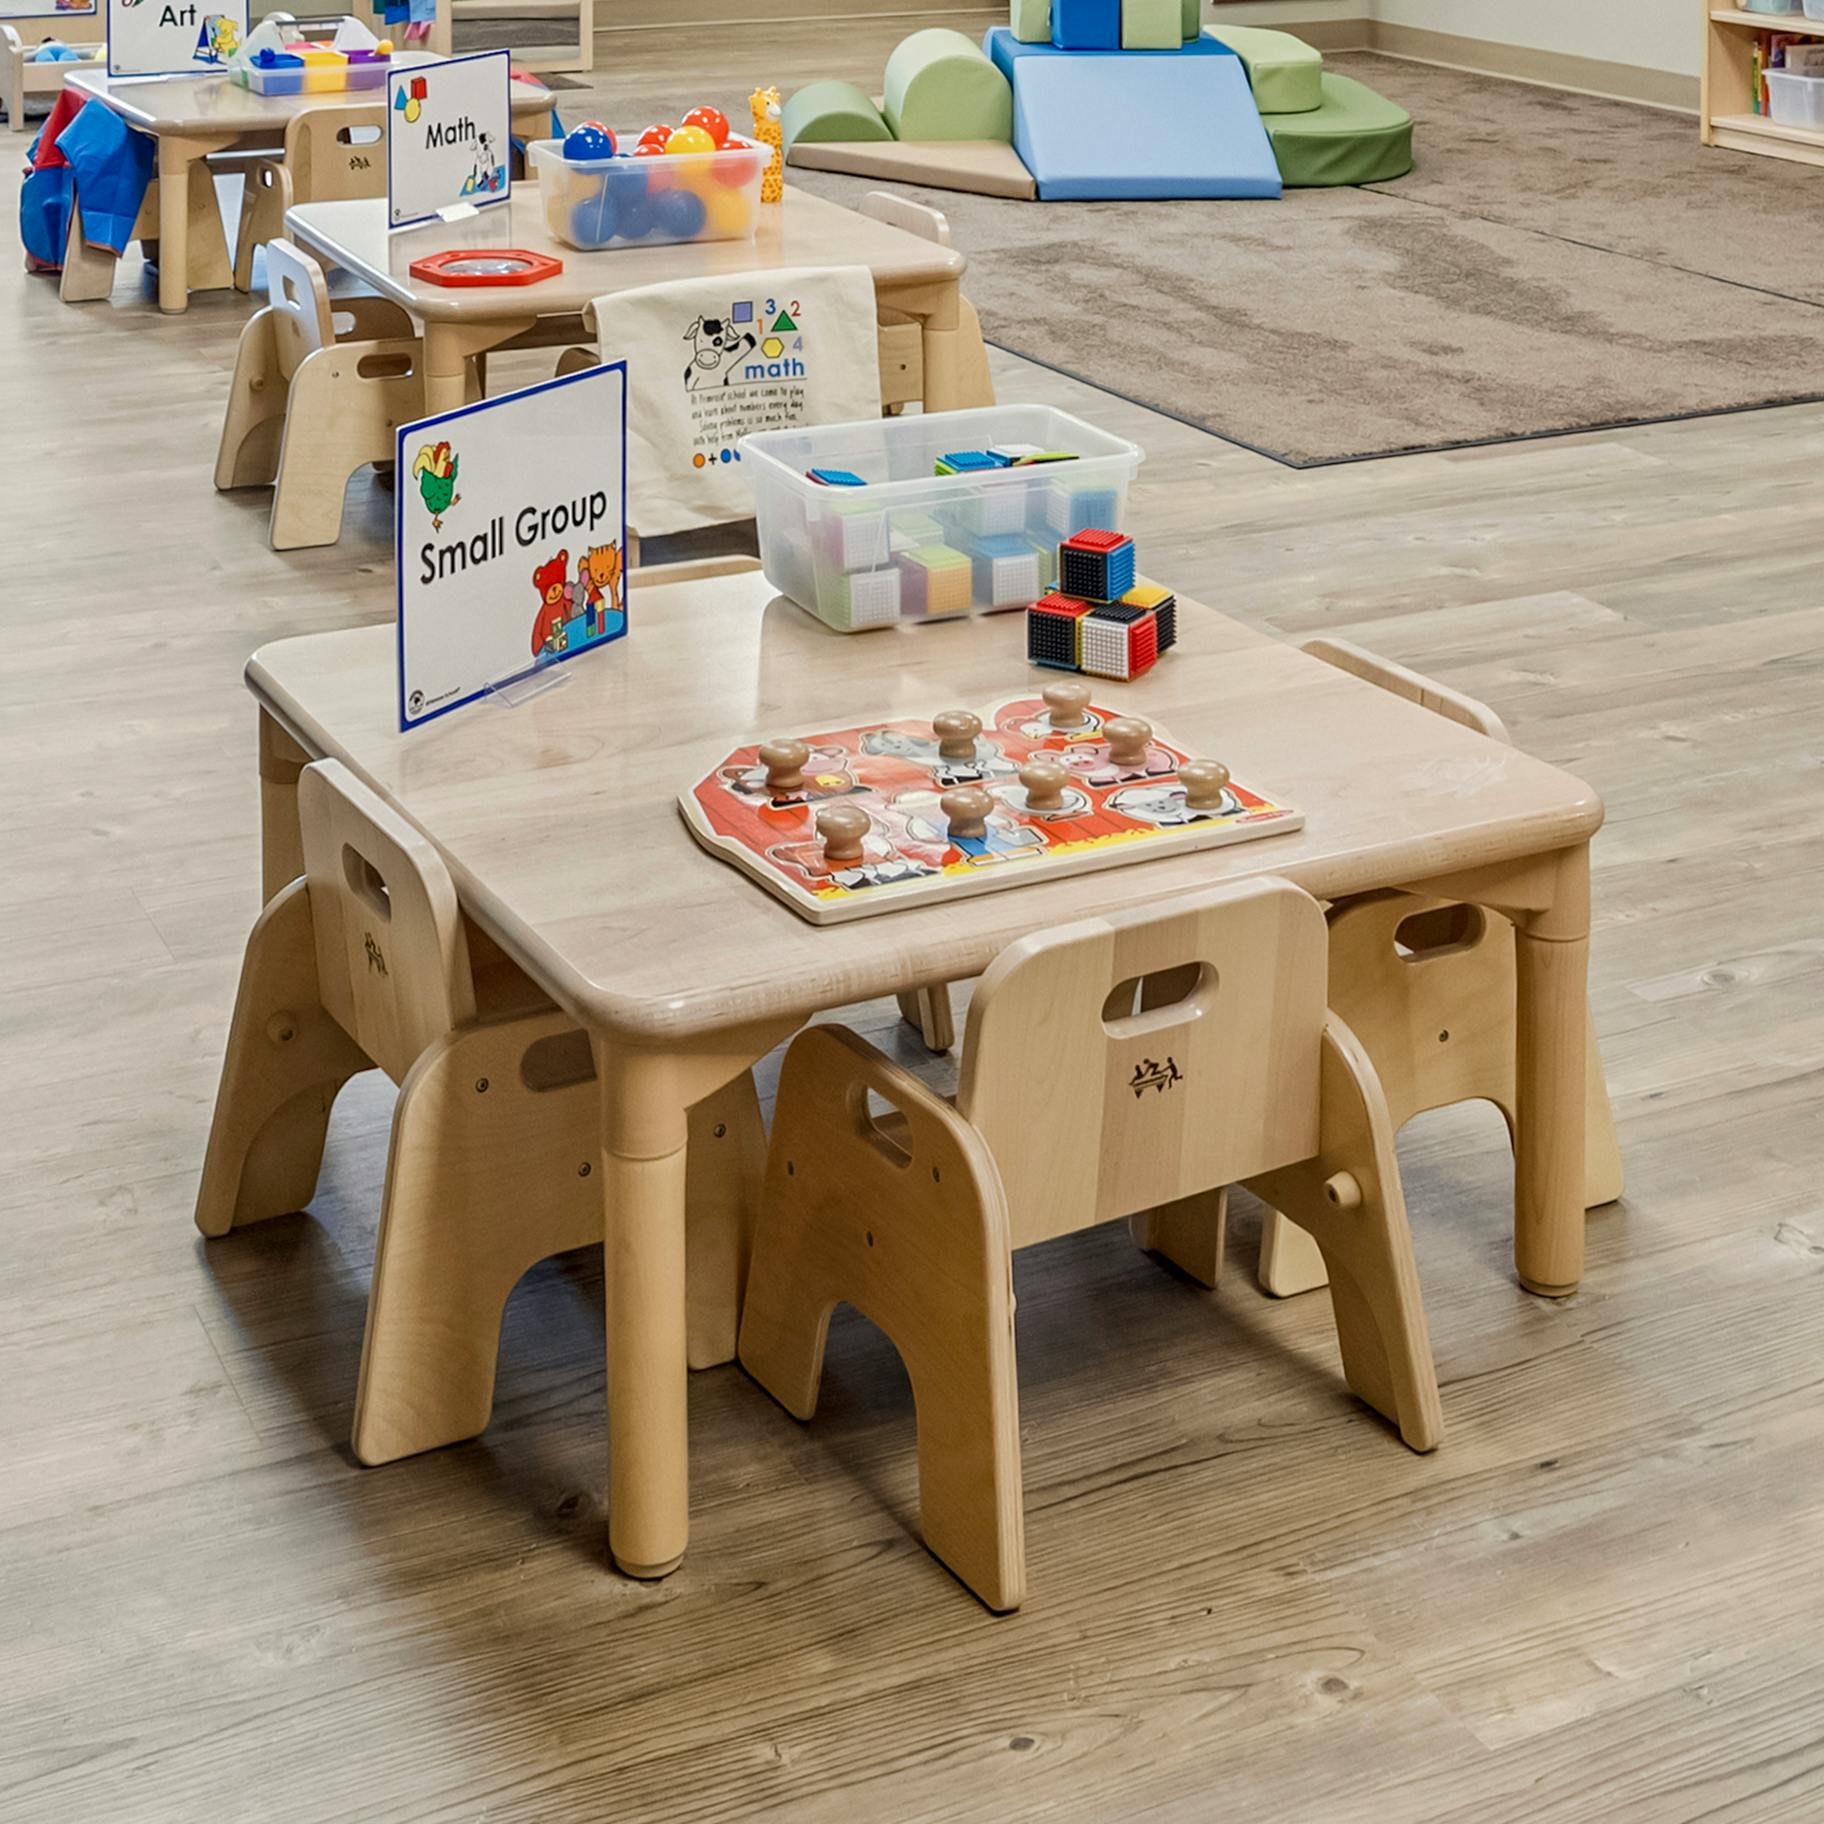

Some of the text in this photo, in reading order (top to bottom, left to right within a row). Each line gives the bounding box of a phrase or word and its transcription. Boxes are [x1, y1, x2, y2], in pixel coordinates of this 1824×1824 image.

[159, 3, 197, 27] Art
[425, 115, 476, 150] Math
[765, 298, 801, 317] 3 2
[757, 319, 763, 334] 1
[792, 336, 803, 352] 4
[744, 357, 805, 380] math
[768, 401, 788, 412] every
[419, 489, 607, 586] Small Group
